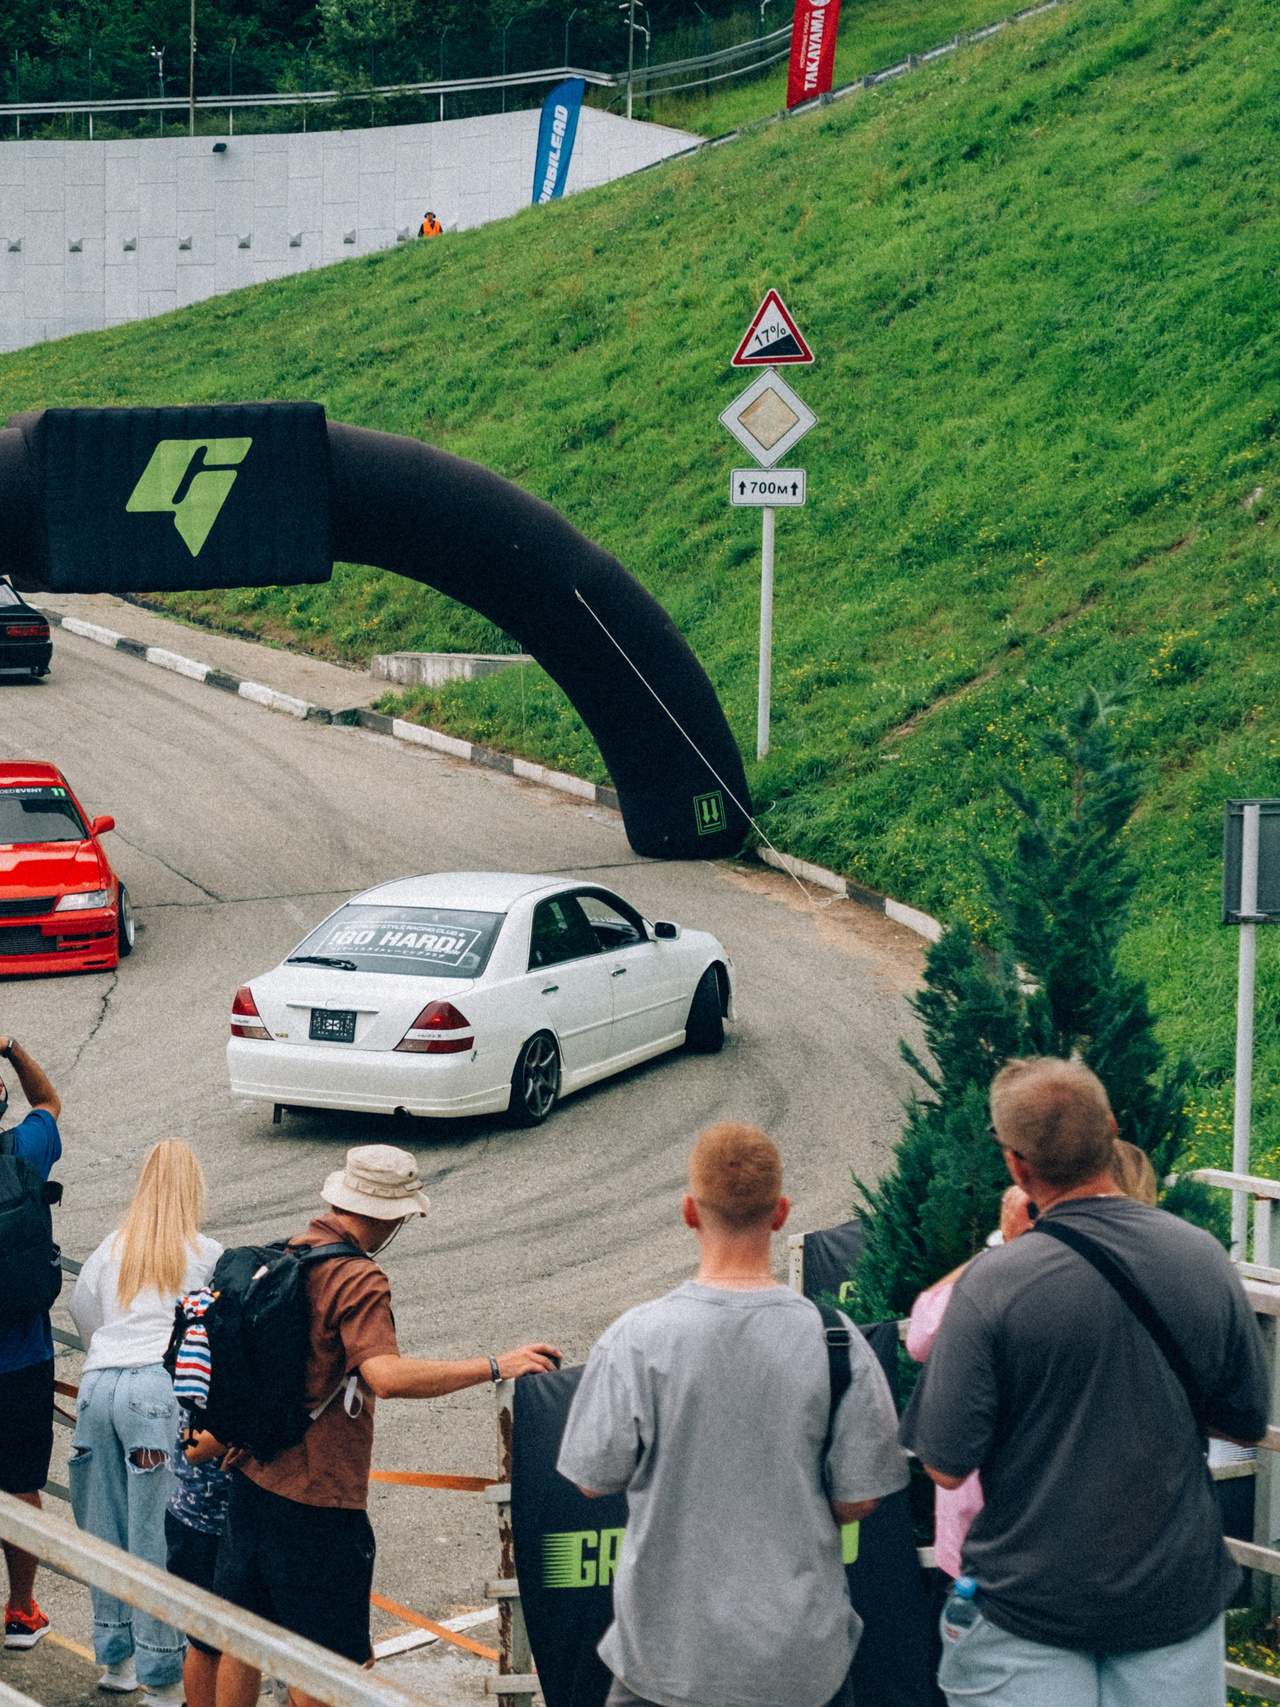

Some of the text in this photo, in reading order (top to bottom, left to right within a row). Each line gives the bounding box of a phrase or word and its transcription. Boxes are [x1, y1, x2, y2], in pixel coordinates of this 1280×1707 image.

[804, 8, 826, 92] TAKAYAMA
[754, 322, 787, 348] 17%
[50, 786, 67, 797] 11
[378, 931, 467, 951] HARD!
[435, 927, 458, 936] CLUB
